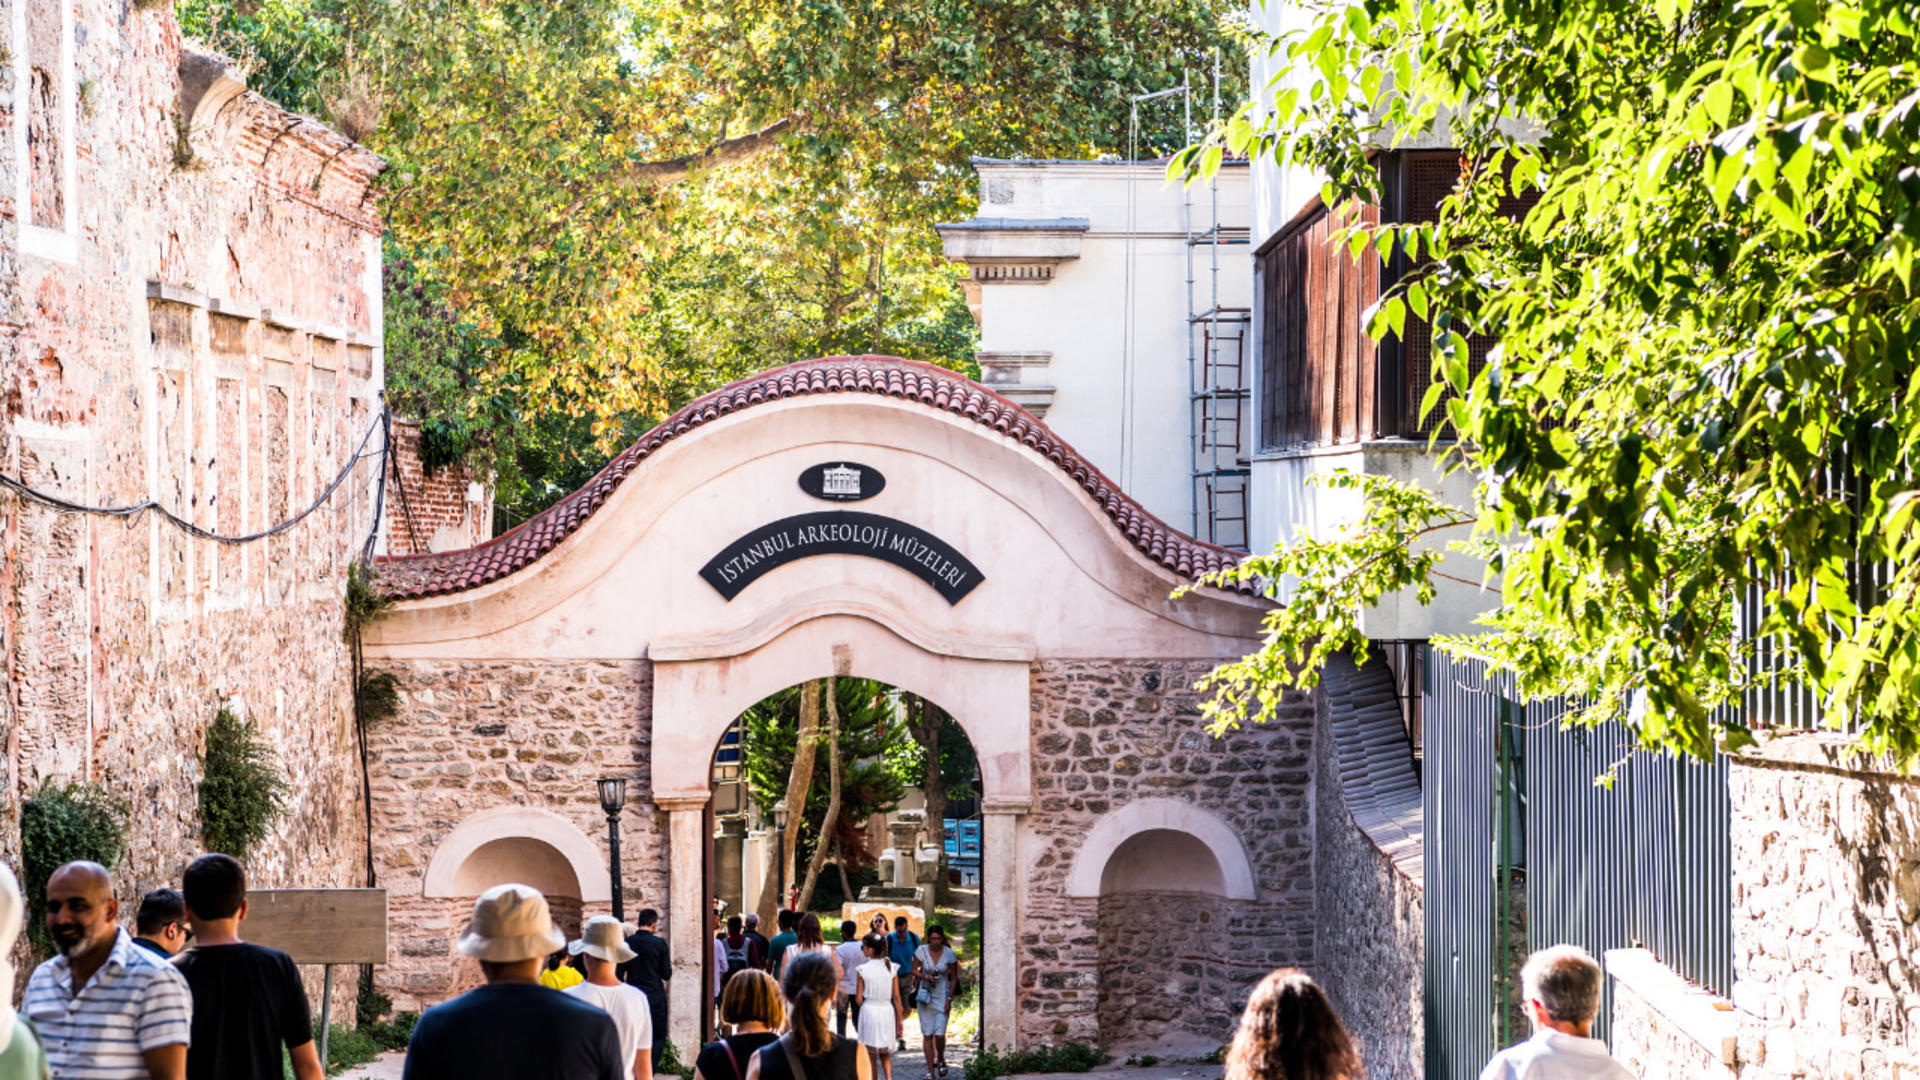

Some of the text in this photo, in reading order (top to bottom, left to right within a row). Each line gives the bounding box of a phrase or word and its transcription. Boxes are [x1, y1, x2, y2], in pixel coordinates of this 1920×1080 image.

[716, 523, 967, 588] İSTANBUL ARKEOLOJİ MÜZELERİ
